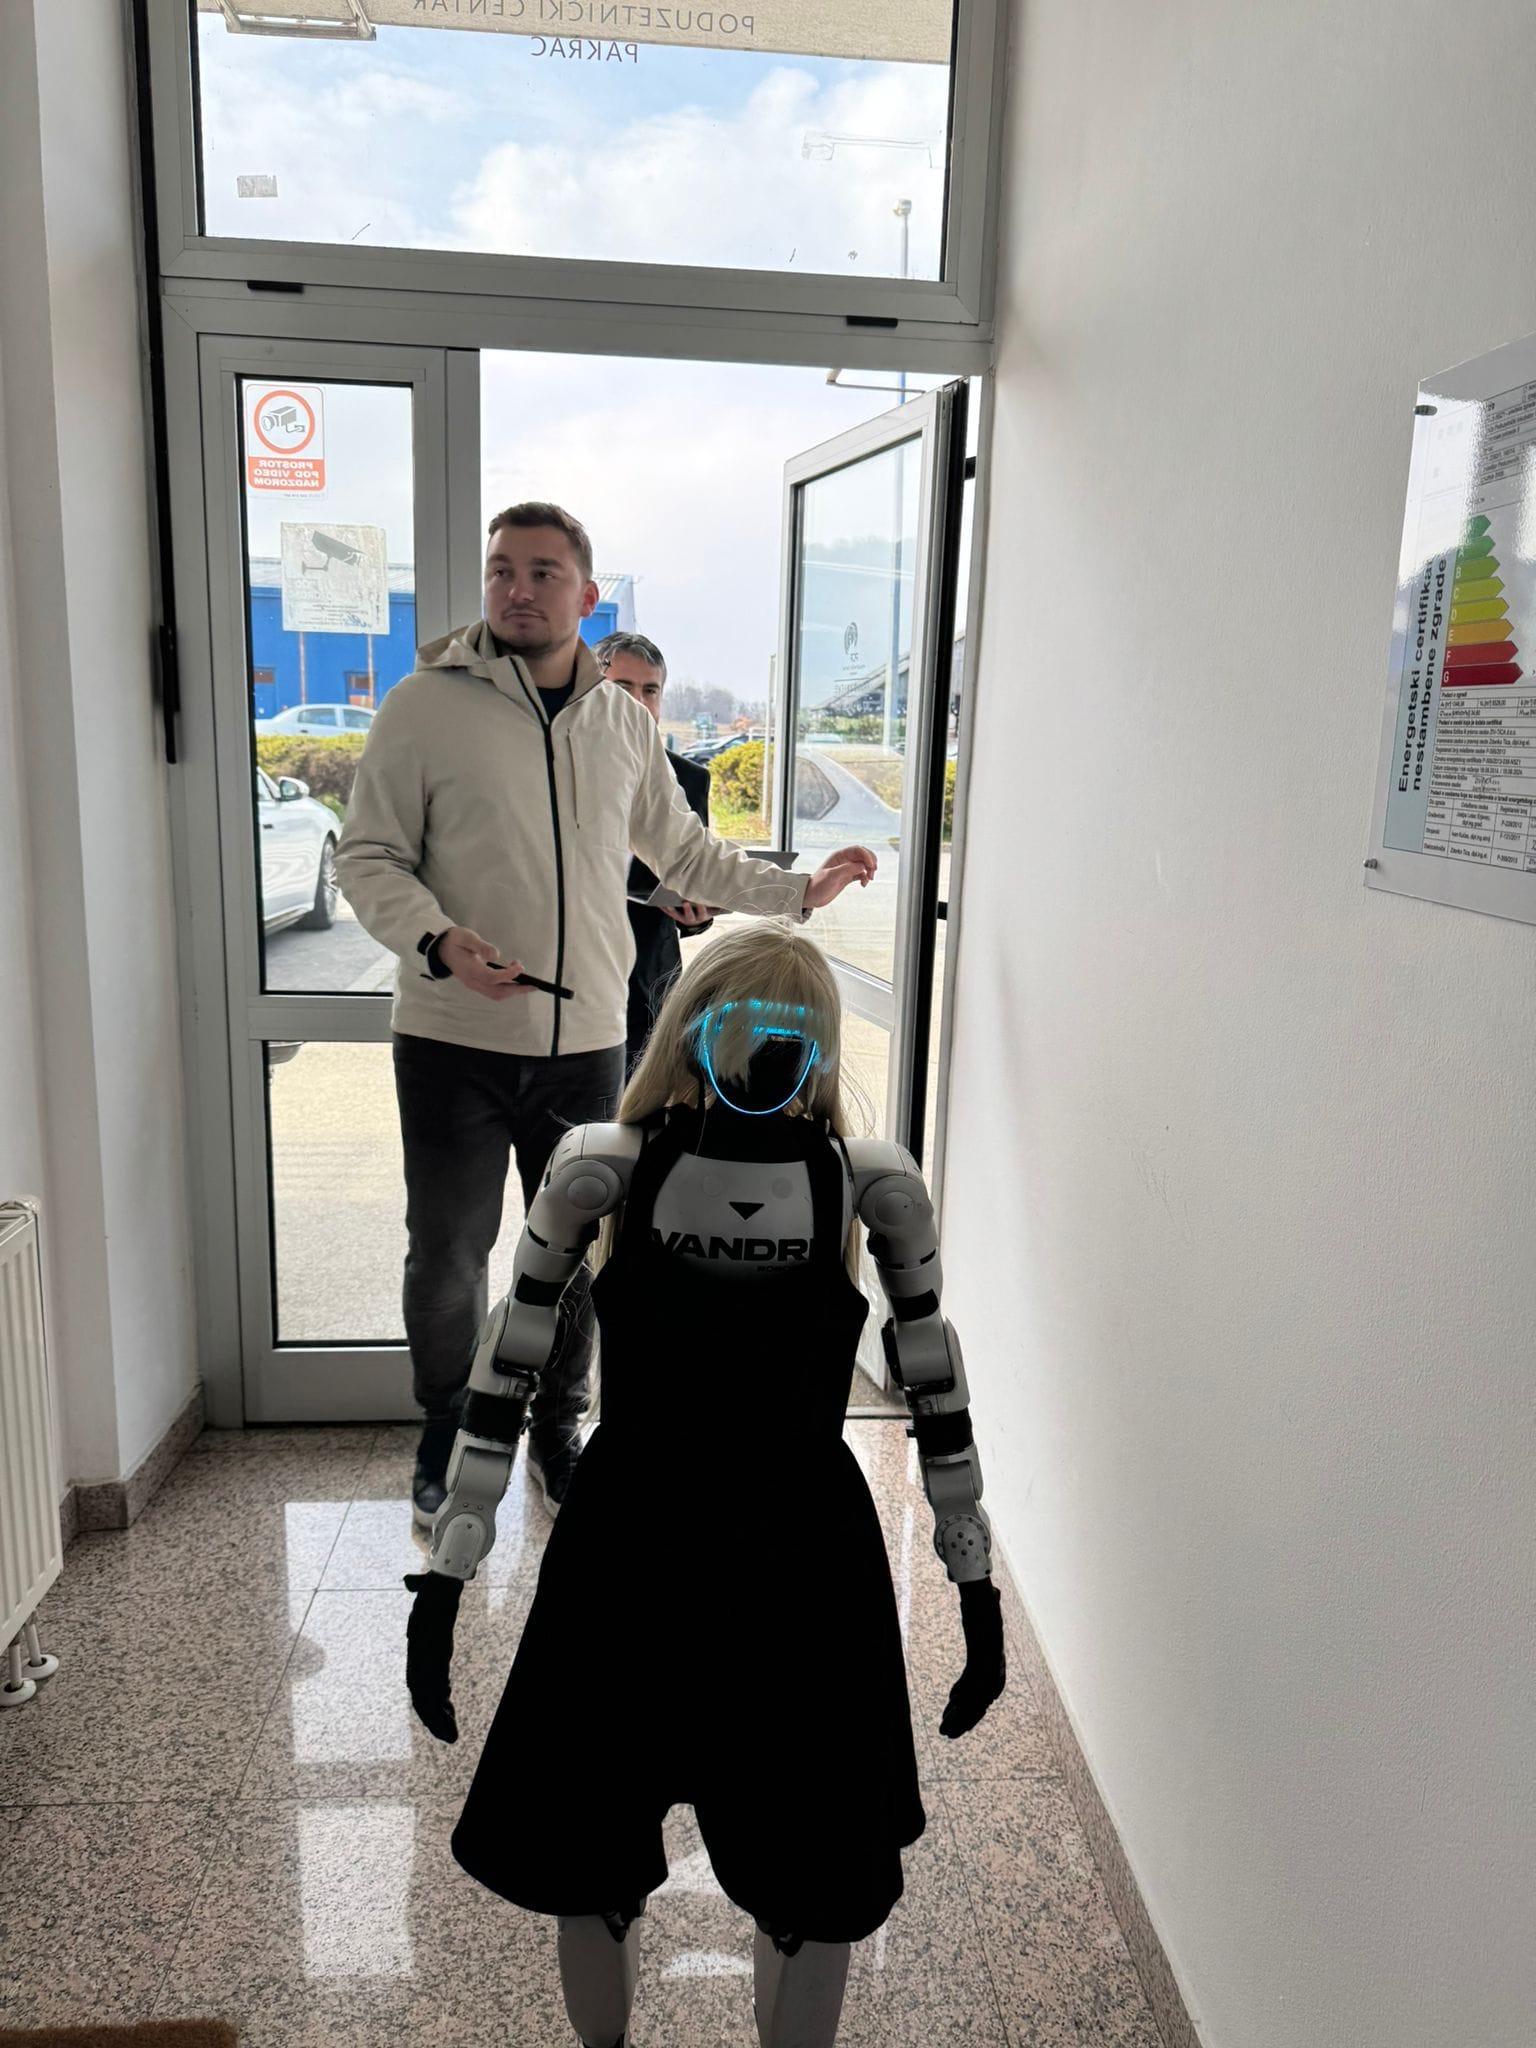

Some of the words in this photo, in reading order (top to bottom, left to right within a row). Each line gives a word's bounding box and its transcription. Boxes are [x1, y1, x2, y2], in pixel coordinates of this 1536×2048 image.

[1413, 648, 1437, 791] nestambene
[1430, 558, 1447, 641] zgrade
[1443, 671, 1450, 683] G
[1445, 649, 1452, 664] F
[1398, 670, 1421, 792] Energetski
